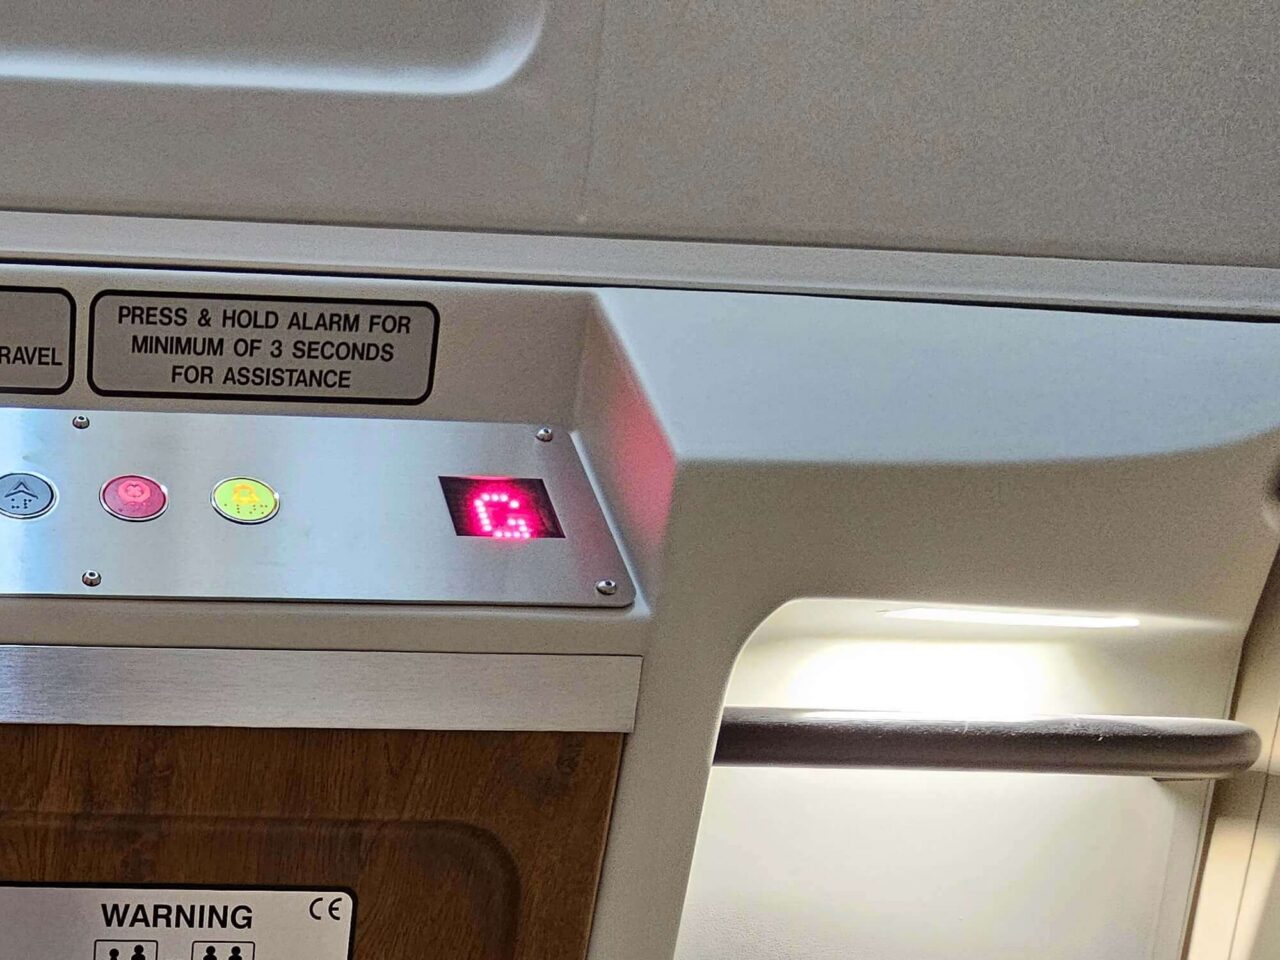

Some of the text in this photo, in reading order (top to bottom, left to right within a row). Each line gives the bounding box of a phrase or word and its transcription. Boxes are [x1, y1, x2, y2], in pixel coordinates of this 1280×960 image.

[118, 306, 411, 334] PRESS & HOLD ALARM FOR
[131, 335, 394, 362] MINIMUM OF 3 SECONDS
[171, 365, 351, 389] FOR ASSISTANCE
[474, 493, 531, 539] G
[101, 904, 253, 929] WARNING
